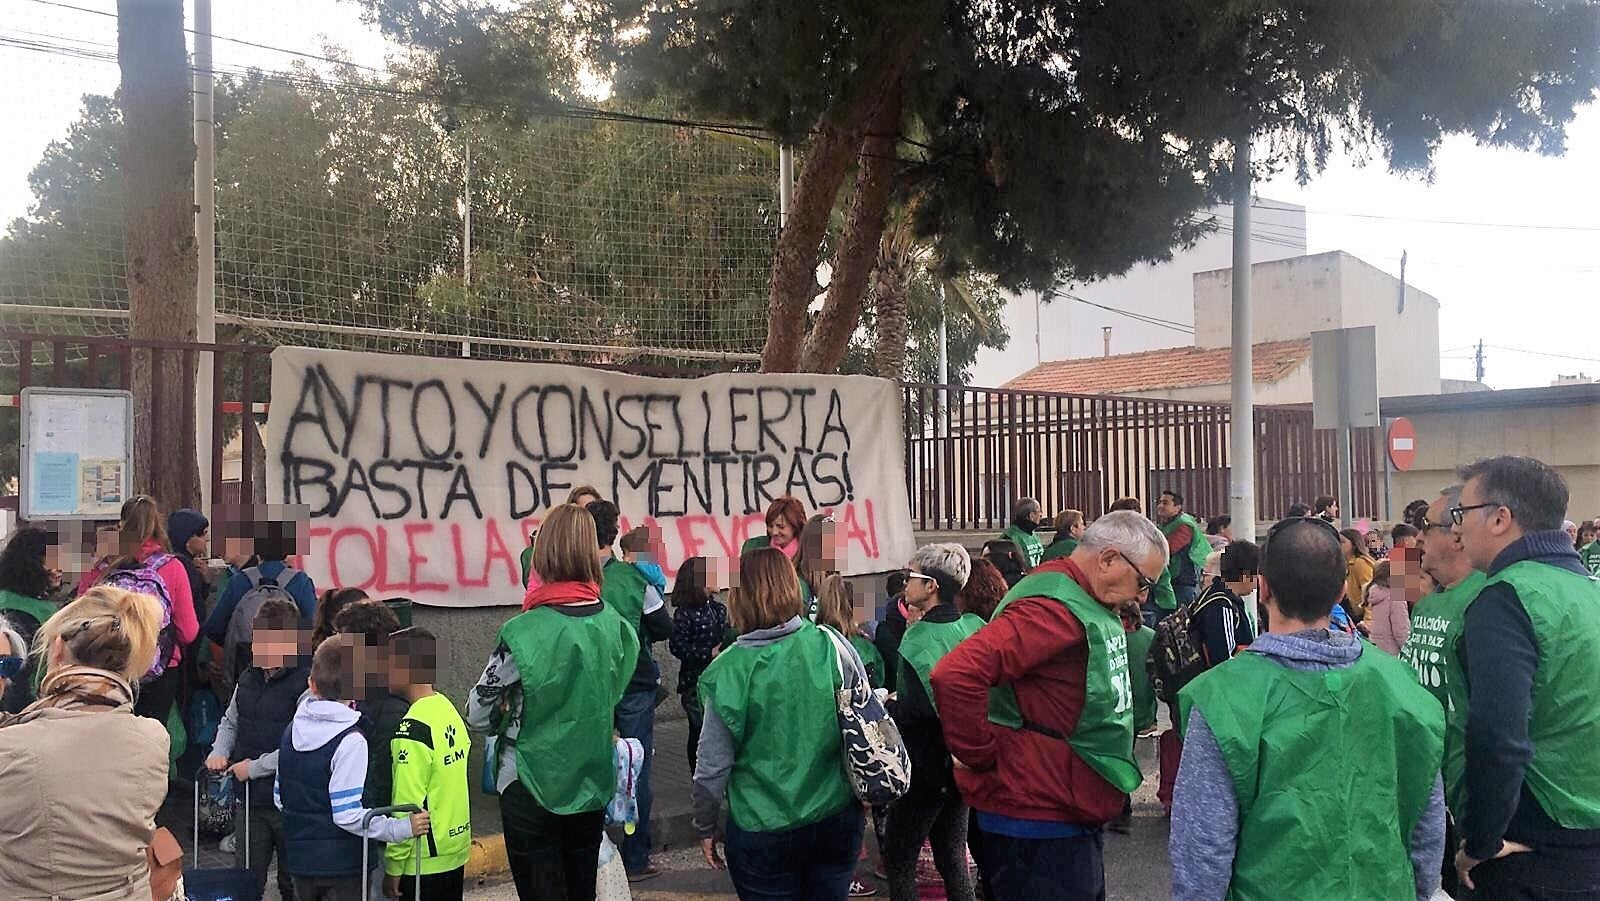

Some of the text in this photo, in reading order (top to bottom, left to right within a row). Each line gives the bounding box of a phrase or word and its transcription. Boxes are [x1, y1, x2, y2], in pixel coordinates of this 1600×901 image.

[463, 380, 507, 459] Y
[511, 384, 852, 462] CONSELLERIA
[611, 451, 855, 518] MENTIRAS!
[450, 517, 519, 588] LA
